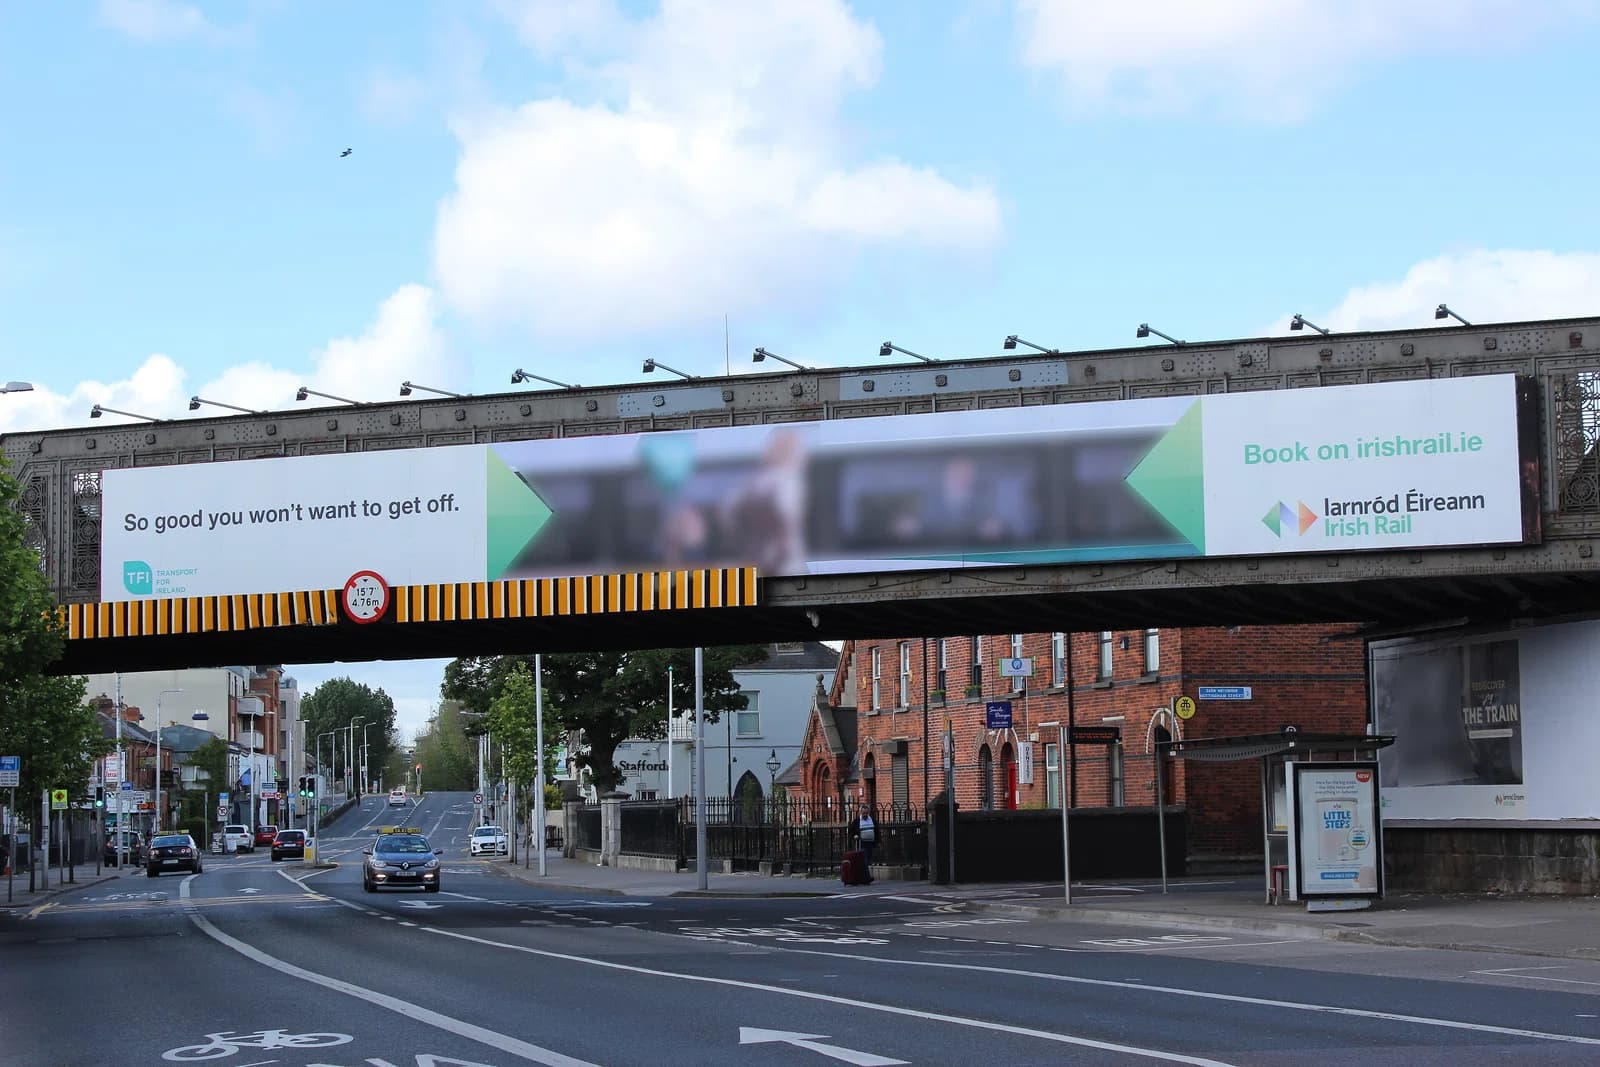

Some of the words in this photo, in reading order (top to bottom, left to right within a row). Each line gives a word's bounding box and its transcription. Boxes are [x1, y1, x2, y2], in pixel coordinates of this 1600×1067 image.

[1244, 441, 1310, 465] Book
[1317, 442, 1349, 461] on
[1356, 431, 1483, 459] irishrail.ie
[1324, 494, 1399, 517] Iarnród
[1406, 488, 1486, 512] Éireann
[124, 513, 149, 532] So
[155, 509, 203, 534] good
[208, 510, 243, 531] you
[249, 503, 303, 524] won't
[308, 500, 357, 520] want
[362, 499, 382, 516] to
[388, 496, 421, 520] get
[427, 493, 460, 513] off.
[1324, 514, 1370, 537] Irish
[1374, 513, 1412, 535] Rail
[127, 571, 150, 585] TFI
[156, 568, 198, 577] TRANSPORT
[156, 578, 170, 586] FOR
[156, 586, 186, 594] IRELAND
[352, 597, 380, 607] 4.76m
[1463, 706, 1483, 724] THE
[1485, 704, 1518, 723] TRAIN
[1323, 810, 1352, 820] LITTLE
[1325, 820, 1351, 829] STEPS
